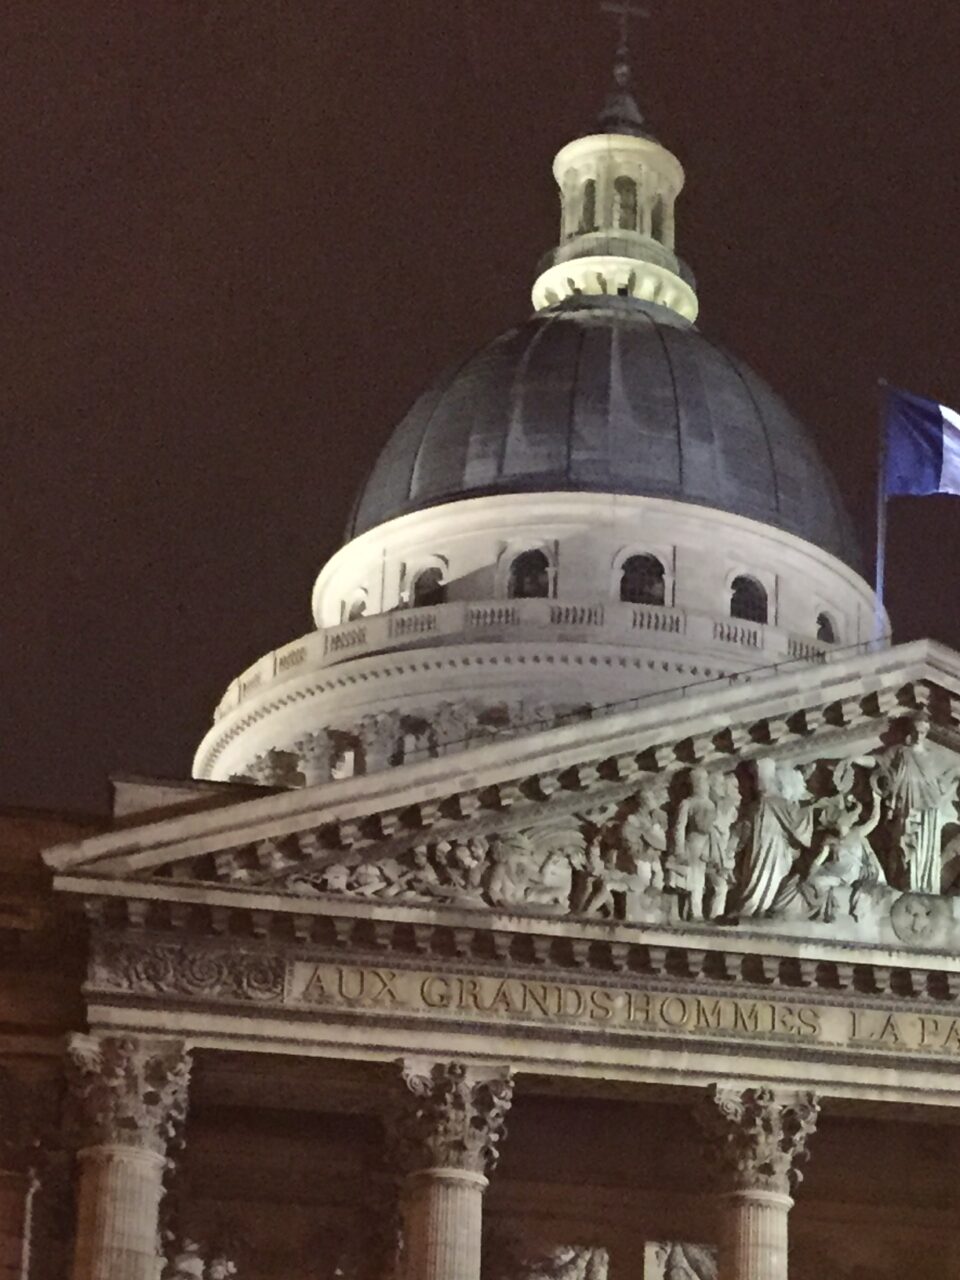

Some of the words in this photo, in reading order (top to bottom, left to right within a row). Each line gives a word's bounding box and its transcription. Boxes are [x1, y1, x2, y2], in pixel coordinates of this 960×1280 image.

[303, 965, 397, 1003] AUX
[419, 976, 613, 1020] GRANDS
[625, 990, 819, 1038] HOMMES
[849, 1010, 899, 1045] LA
